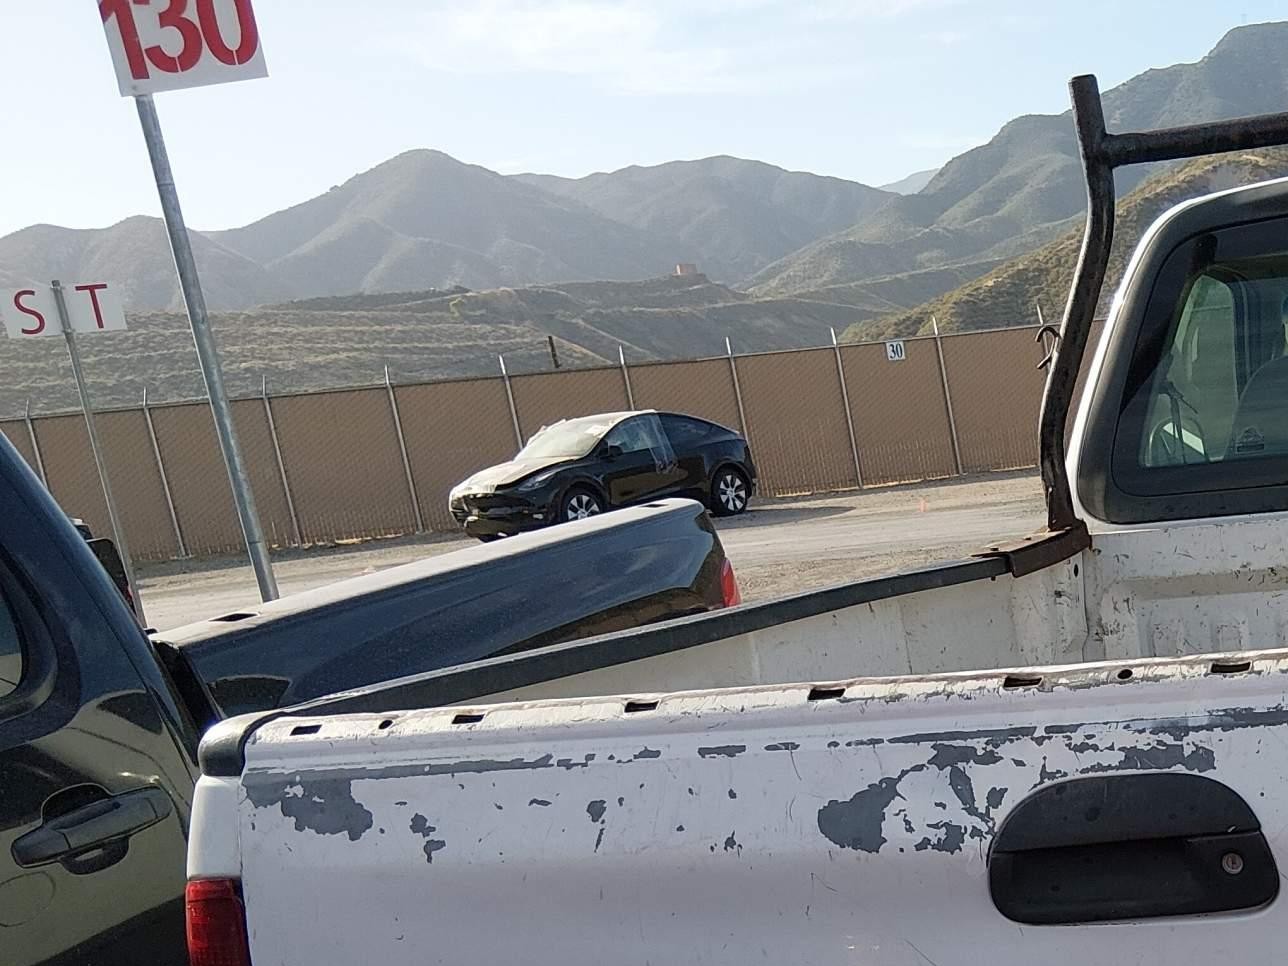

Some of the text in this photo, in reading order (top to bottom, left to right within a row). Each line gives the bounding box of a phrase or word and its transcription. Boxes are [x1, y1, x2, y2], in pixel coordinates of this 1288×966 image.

[99, 0, 259, 80] 130
[14, 289, 46, 335] S
[75, 283, 107, 329] T
[889, 343, 903, 359] 30
